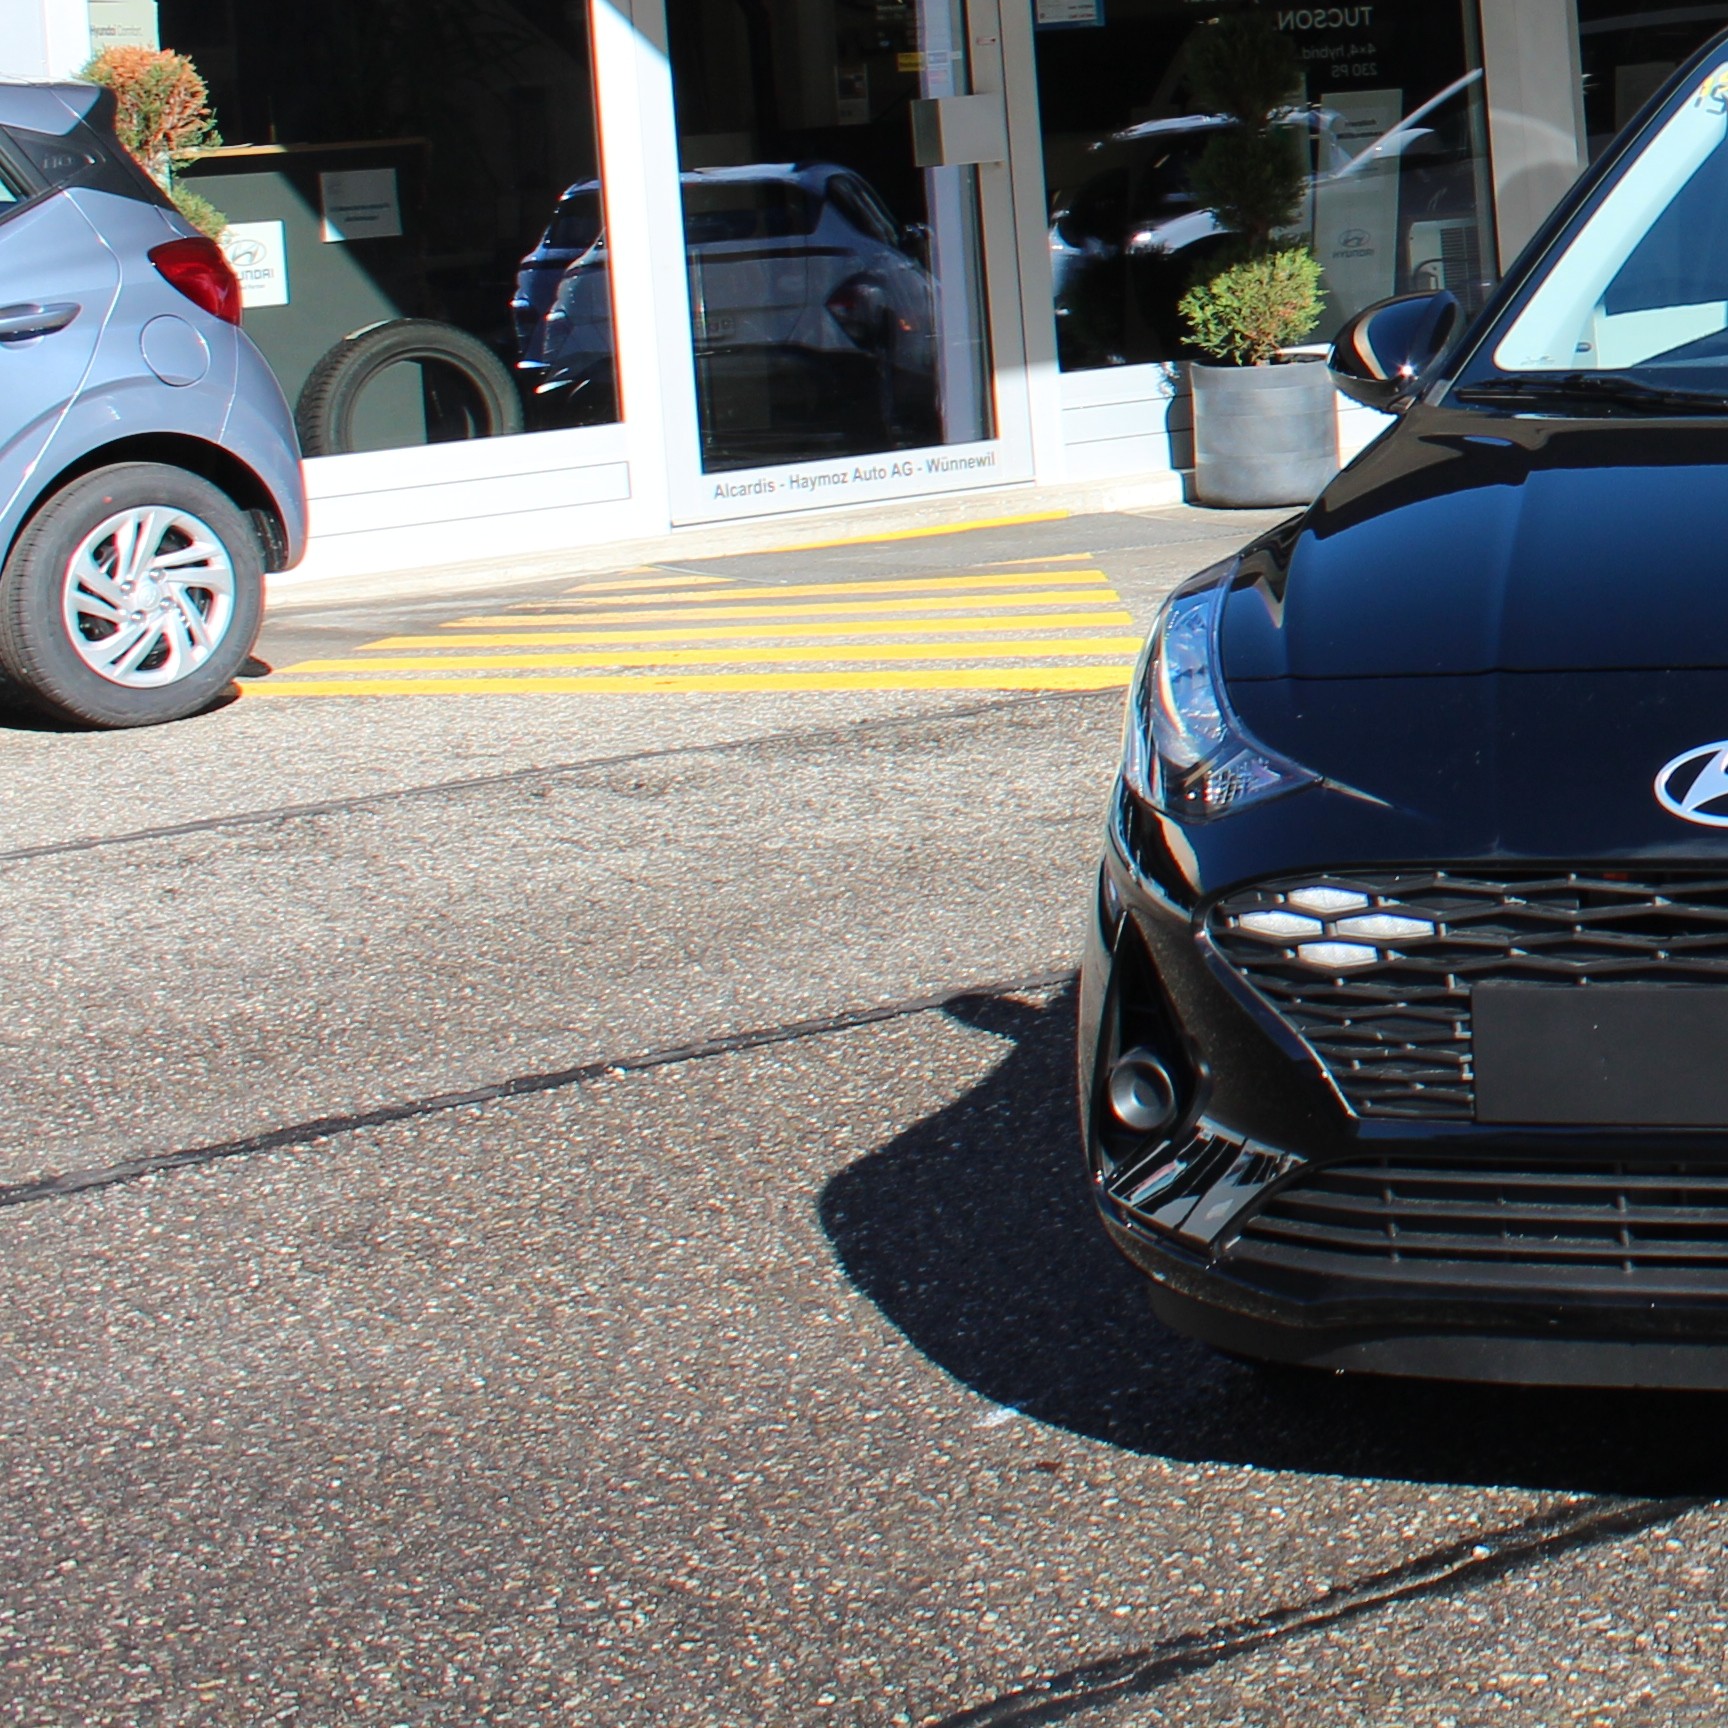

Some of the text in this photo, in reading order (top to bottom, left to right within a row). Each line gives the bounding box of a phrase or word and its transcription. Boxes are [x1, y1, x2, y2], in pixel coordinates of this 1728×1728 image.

[713, 478, 776, 500] Alcardis
[789, 471, 849, 492] Haymoz
[852, 466, 887, 483] Auto
[891, 461, 914, 479] AG
[926, 451, 996, 474] Wünnewil
